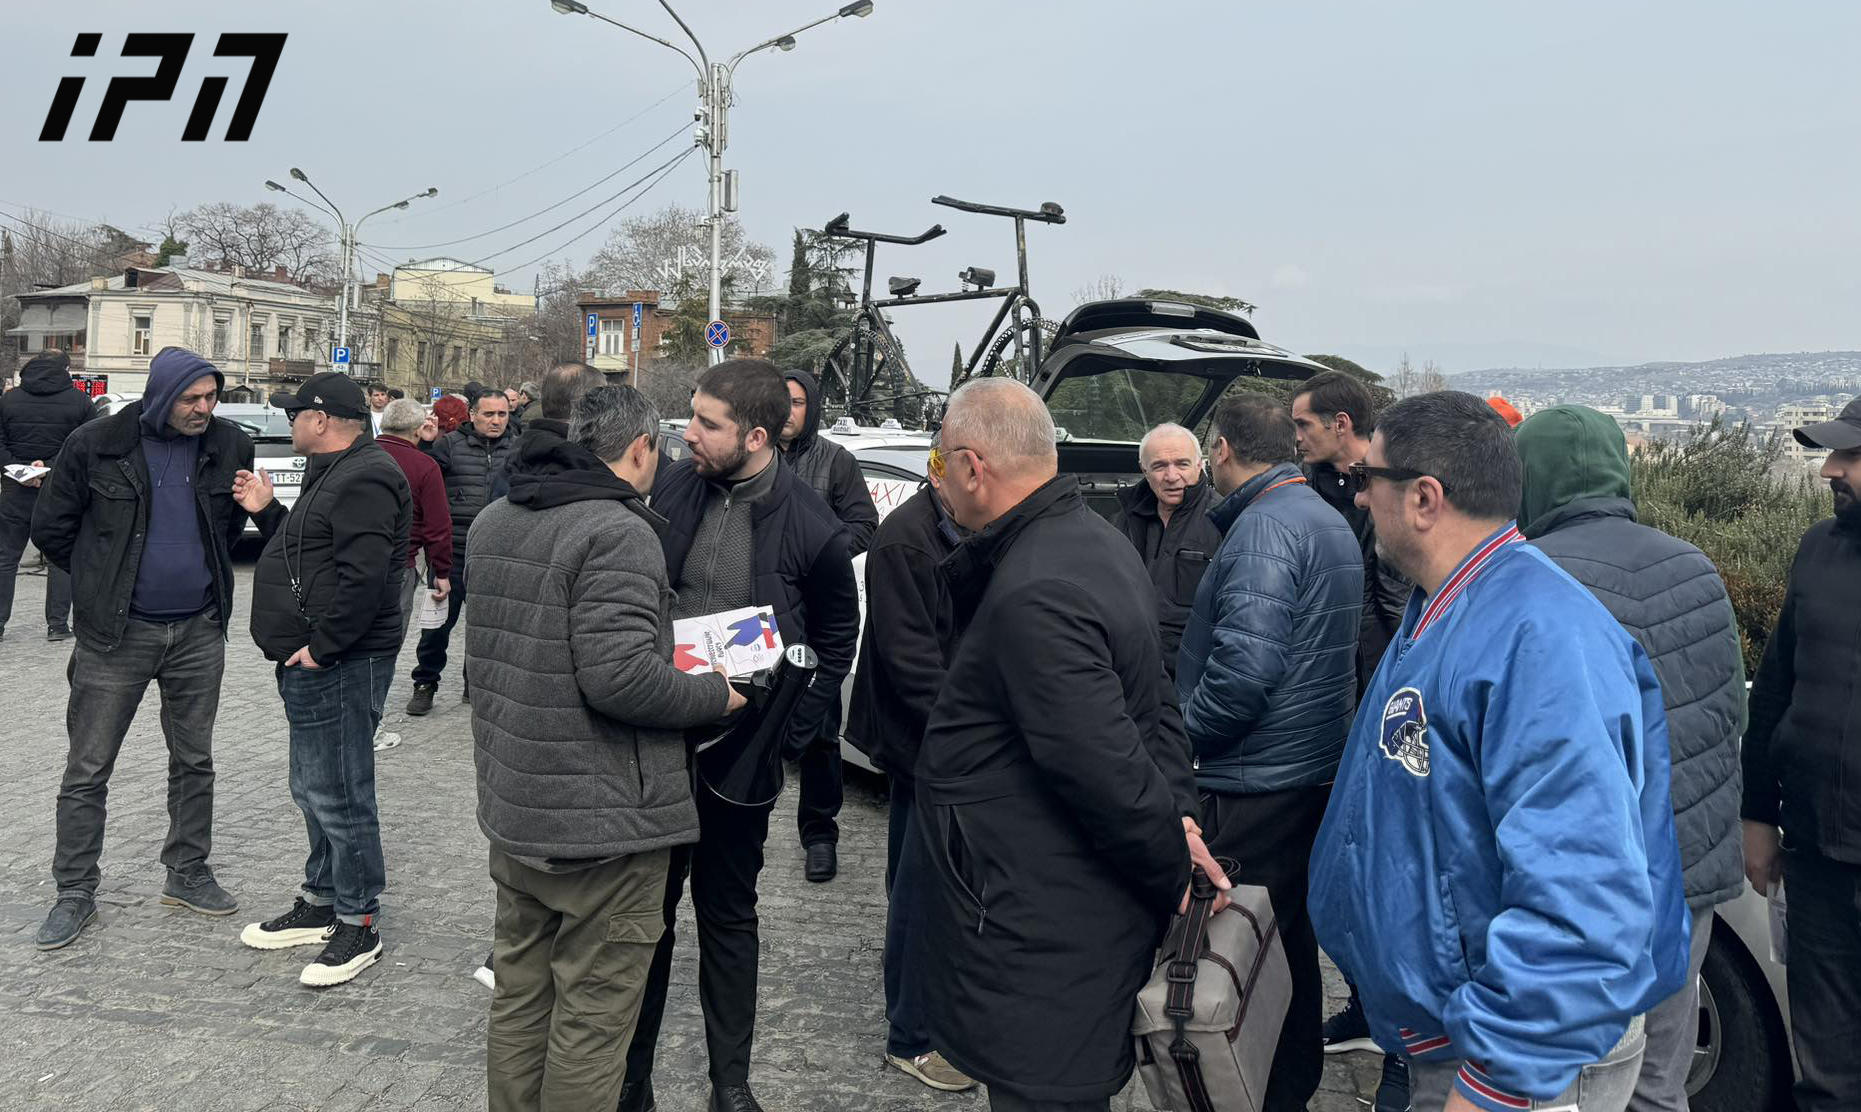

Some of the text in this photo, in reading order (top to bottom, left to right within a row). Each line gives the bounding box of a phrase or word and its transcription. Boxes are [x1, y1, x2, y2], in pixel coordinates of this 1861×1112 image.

[588, 315, 595, 334] P
[336, 348, 346, 361] P
[275, 473, 304, 483] TT-52
[866, 481, 906, 507] AXI
[1387, 697, 1413, 715] GIANTS
